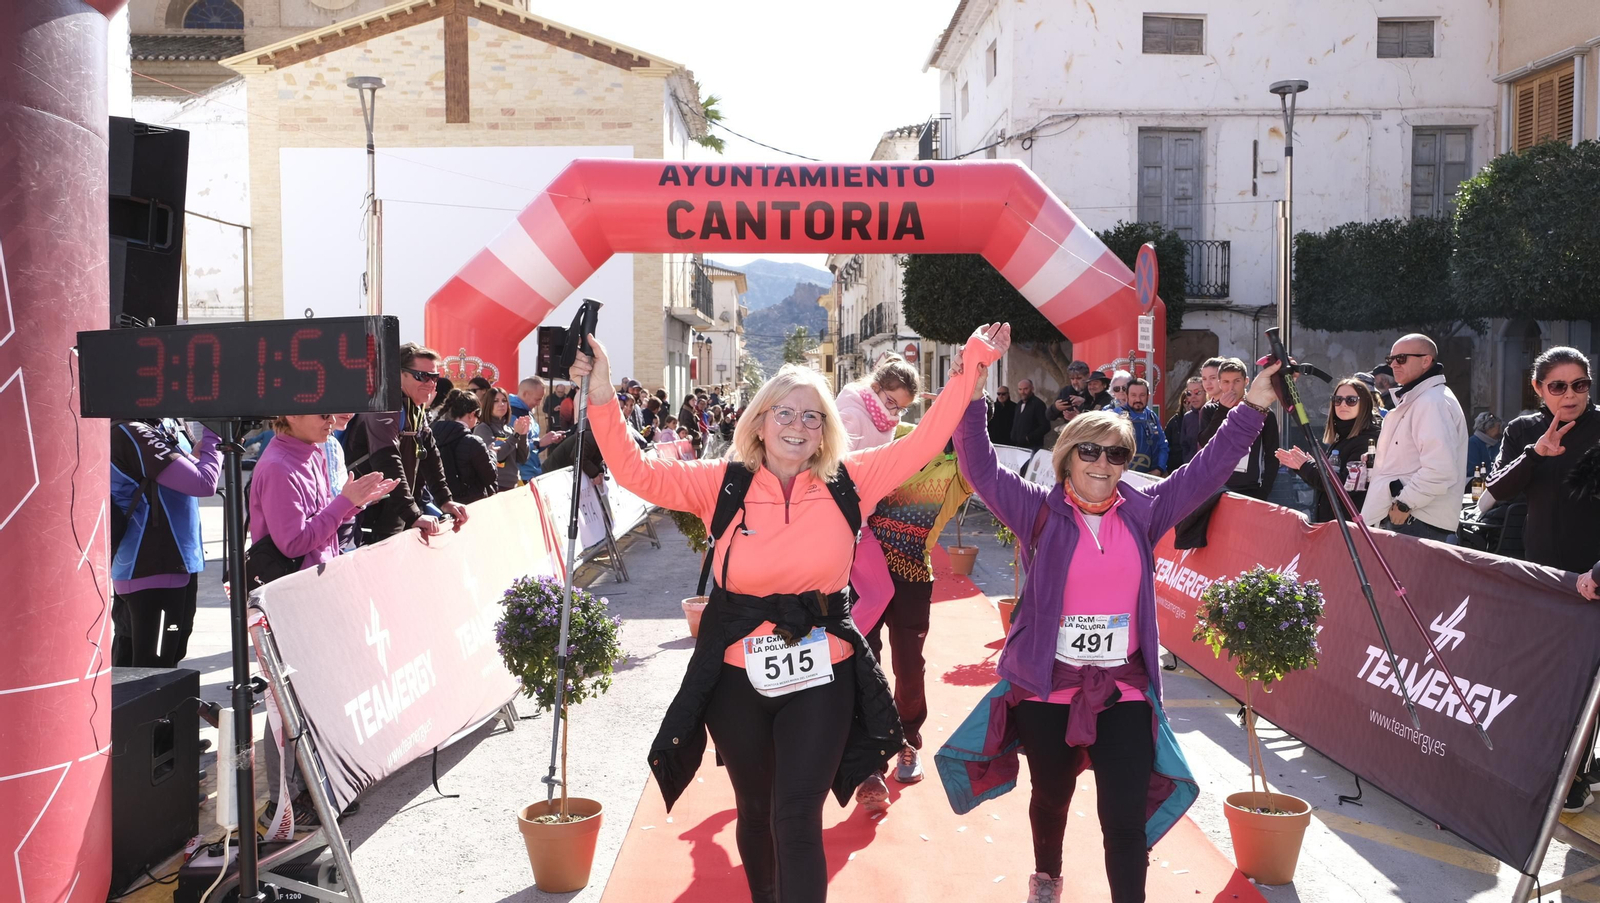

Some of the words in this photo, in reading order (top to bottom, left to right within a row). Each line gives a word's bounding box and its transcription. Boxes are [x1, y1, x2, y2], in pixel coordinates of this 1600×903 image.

[658, 165, 935, 187] AYUNTAMIENTO
[666, 200, 925, 241] CANTORIA
[1153, 557, 1214, 602] TEAMERGY
[1078, 615, 1095, 623] CxM
[753, 646, 763, 654] LA
[1071, 632, 1114, 653] 491
[765, 648, 814, 680] 515
[343, 648, 437, 746] TEAMERGY
[1356, 644, 1518, 731] TEAMERGY
[1369, 708, 1447, 757] www.teamergy.es
[273, 803, 292, 840] OHIBIDO
